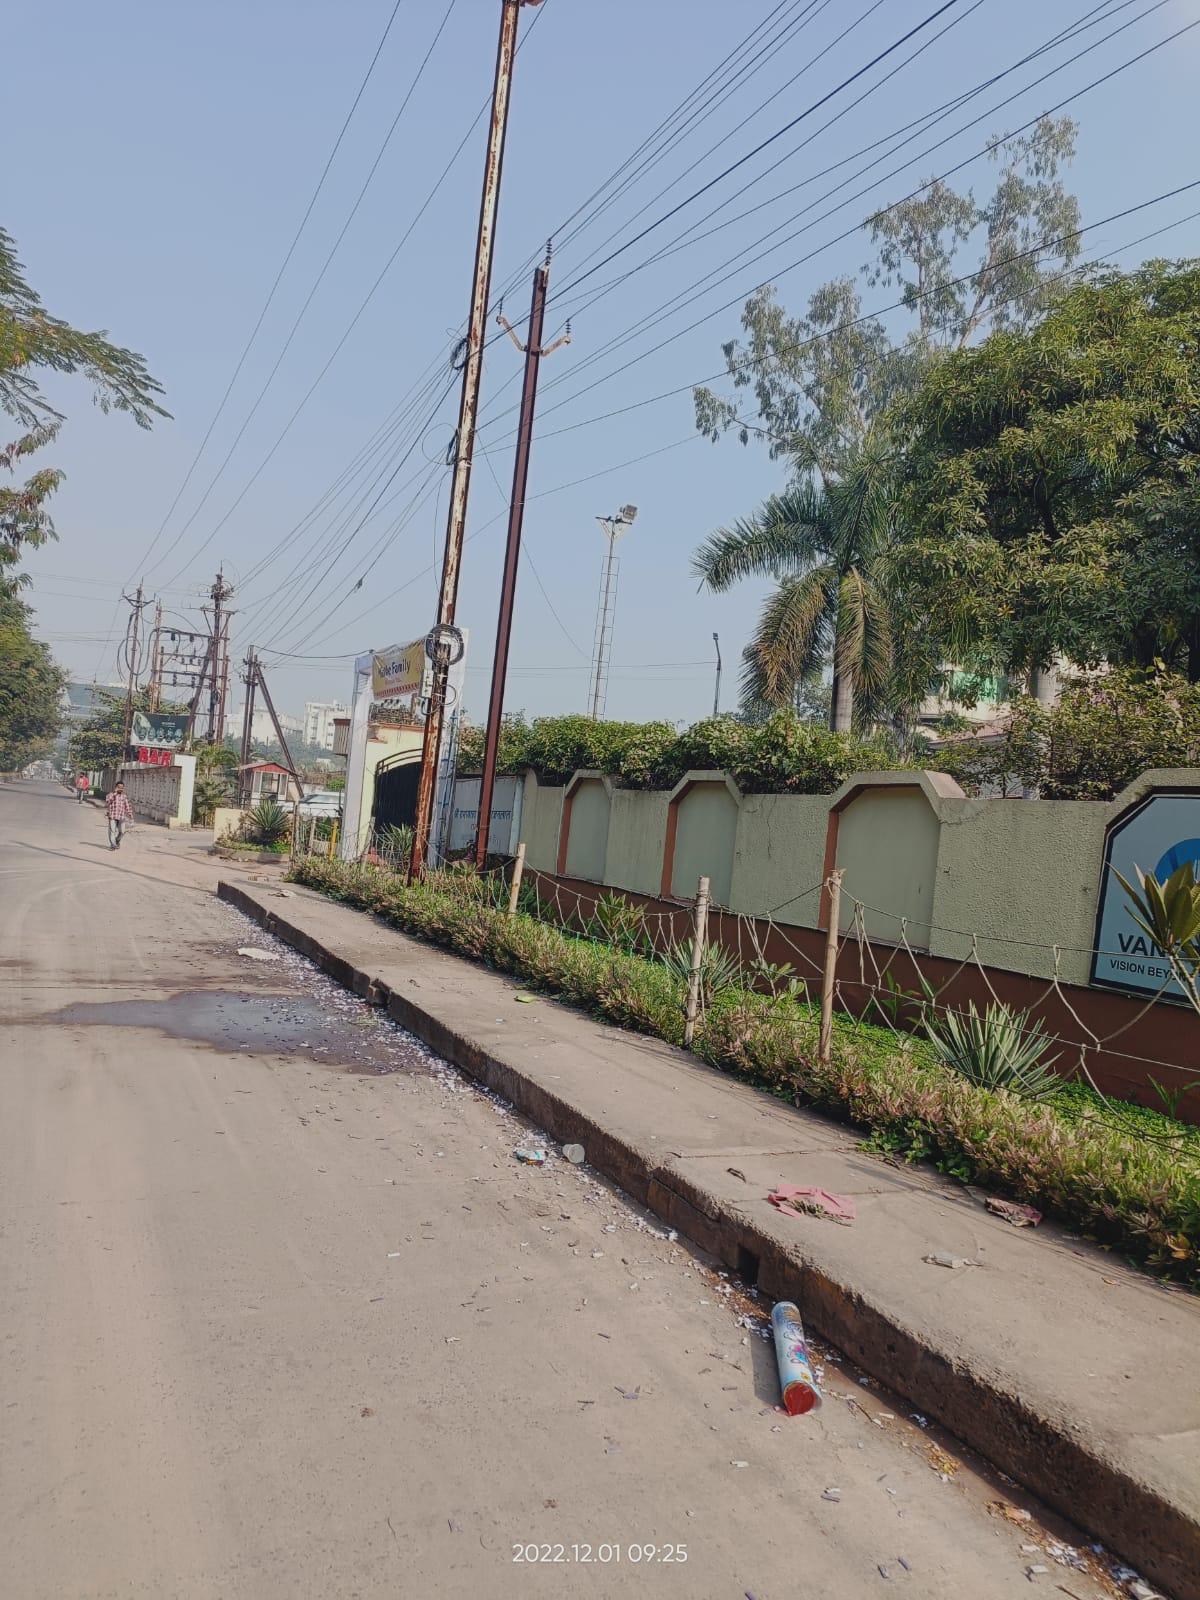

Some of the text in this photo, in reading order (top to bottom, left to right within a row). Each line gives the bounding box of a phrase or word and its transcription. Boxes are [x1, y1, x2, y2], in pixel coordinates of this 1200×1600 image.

[391, 658, 410, 675] Family
[138, 747, 171, 767] BAR
[1110, 959, 1145, 975] VISION
